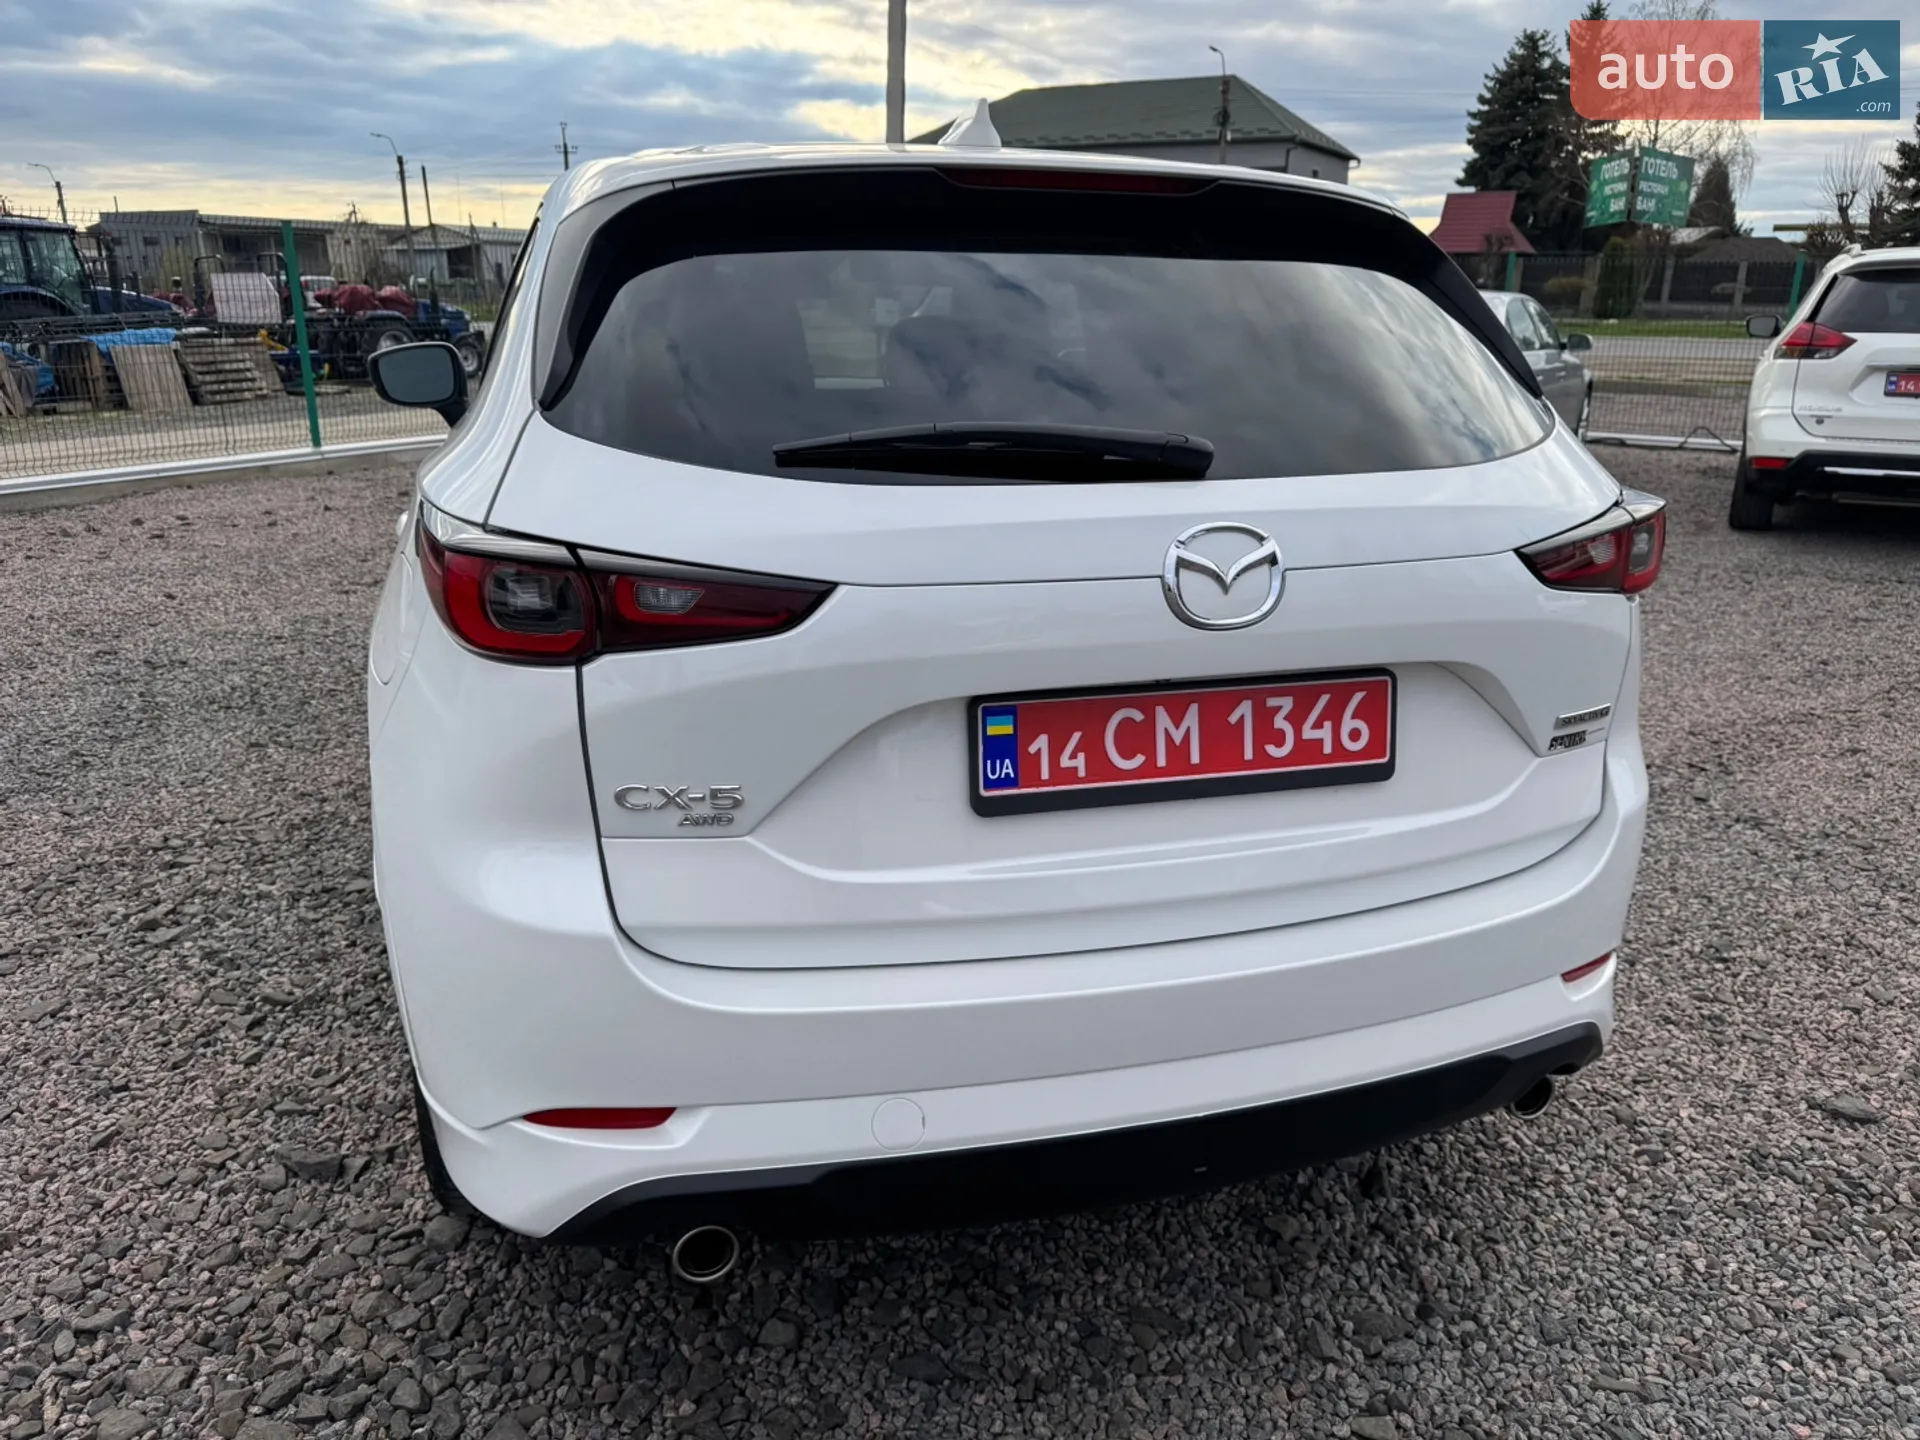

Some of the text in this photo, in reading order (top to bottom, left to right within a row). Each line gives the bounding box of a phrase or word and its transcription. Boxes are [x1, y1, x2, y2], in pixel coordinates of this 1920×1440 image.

[1641, 156, 1679, 179] ГОТЕЛЬ
[1027, 691, 1370, 780] 14 CM 1346
[986, 758, 1015, 780] UA
[614, 783, 745, 811] CX-5
[678, 813, 735, 827] AWD
